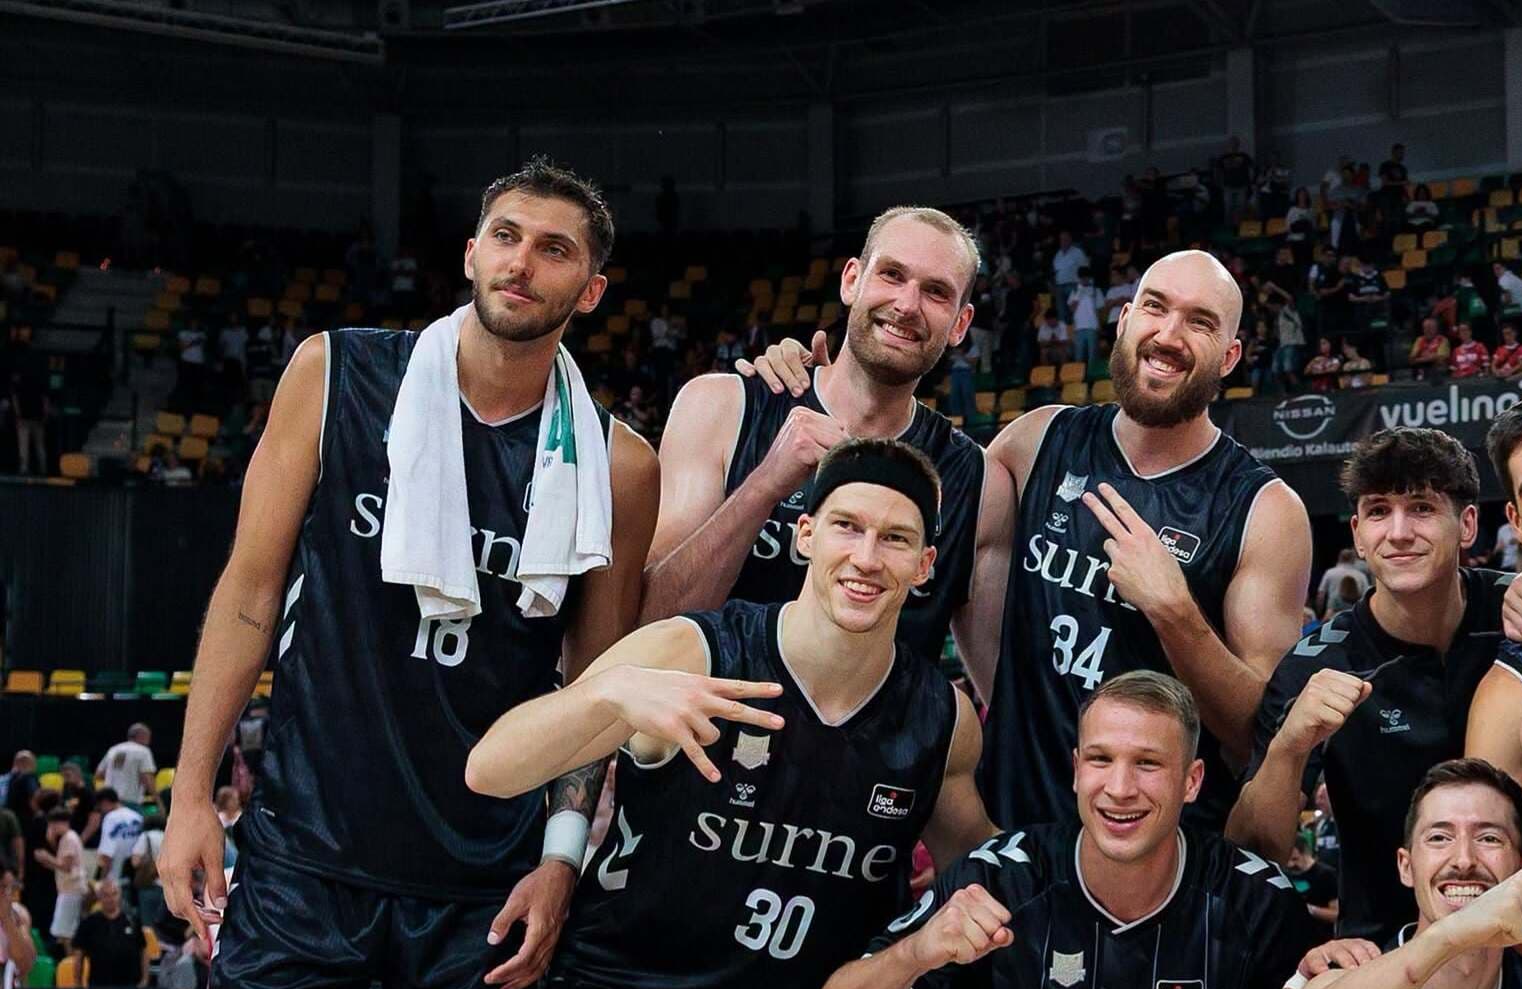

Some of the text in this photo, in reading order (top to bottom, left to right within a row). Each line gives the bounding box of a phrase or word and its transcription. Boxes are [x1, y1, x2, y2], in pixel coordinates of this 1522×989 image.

[1273, 405, 1336, 420] NISSAN
[1023, 533, 1138, 611] sur
[410, 617, 472, 667] 18
[1050, 614, 1112, 690] 34
[688, 811, 897, 883] surne
[734, 887, 816, 960] 30
